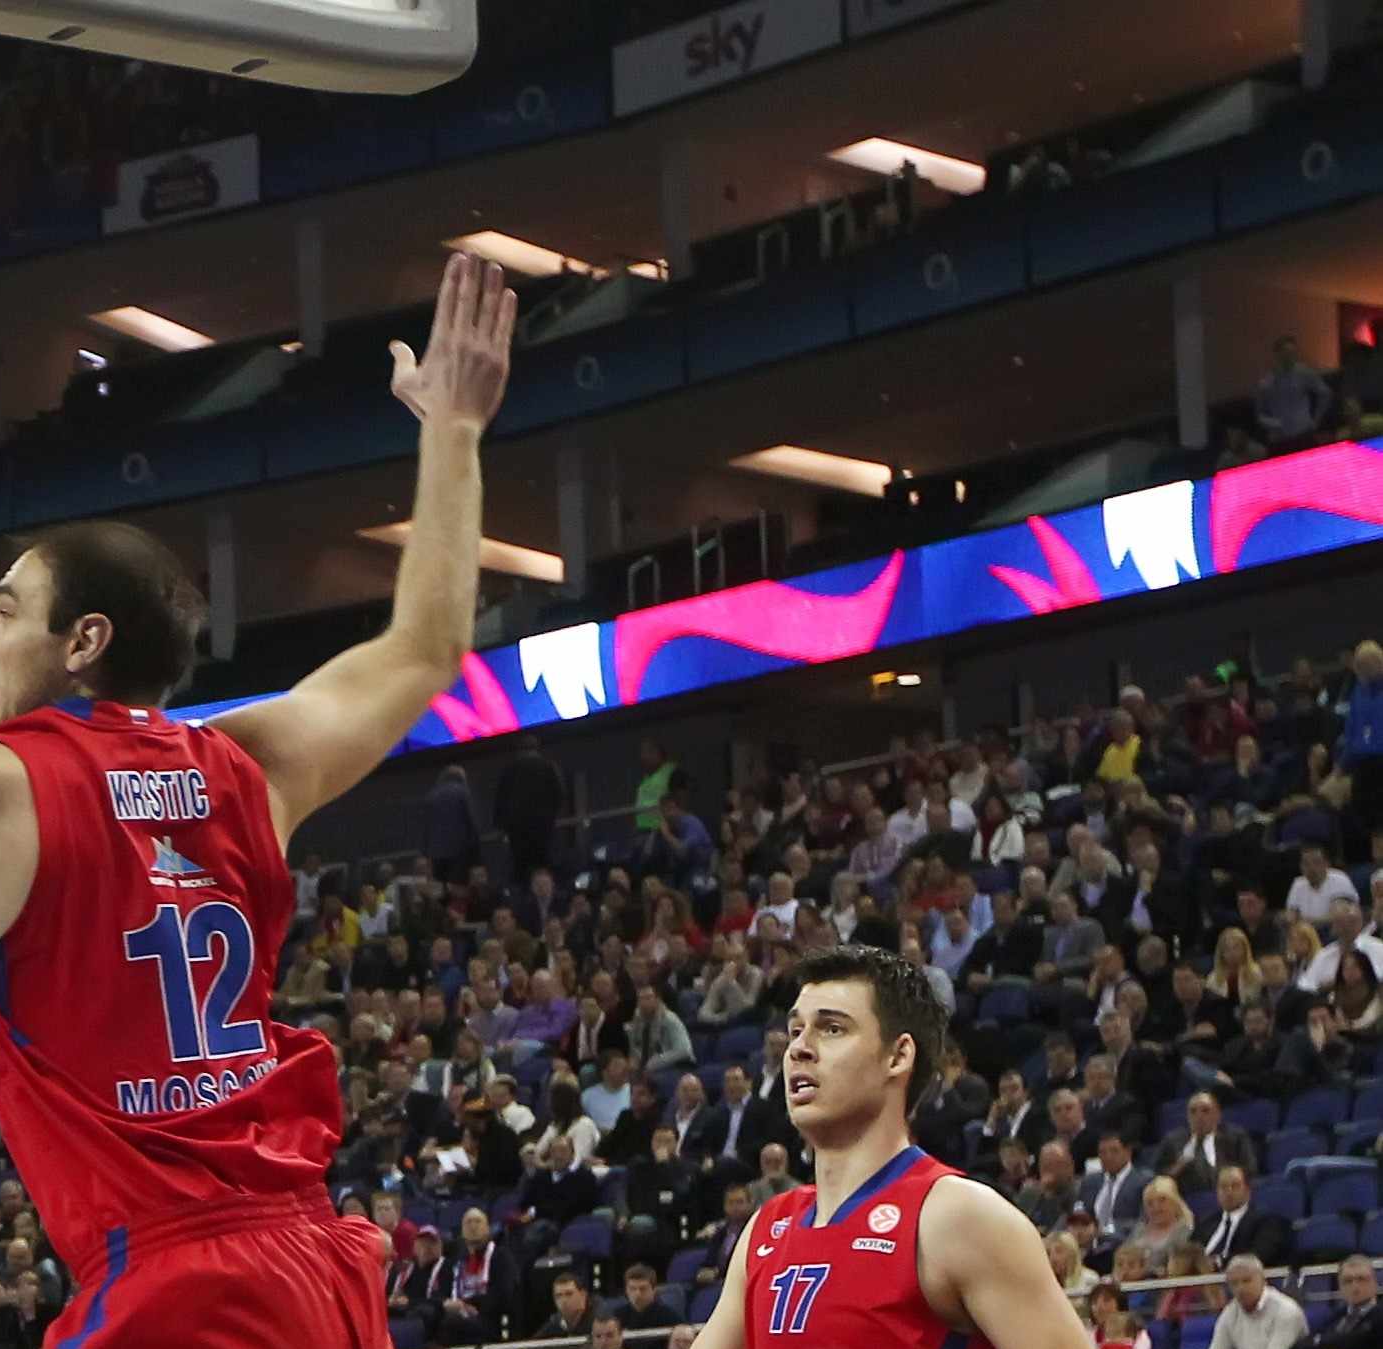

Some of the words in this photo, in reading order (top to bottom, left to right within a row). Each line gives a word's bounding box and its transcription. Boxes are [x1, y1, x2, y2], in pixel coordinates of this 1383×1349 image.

[683, 12, 766, 76] sky
[105, 769, 210, 821] KRSTIC
[123, 901, 267, 1062] 12
[769, 1264, 830, 1333] 17
